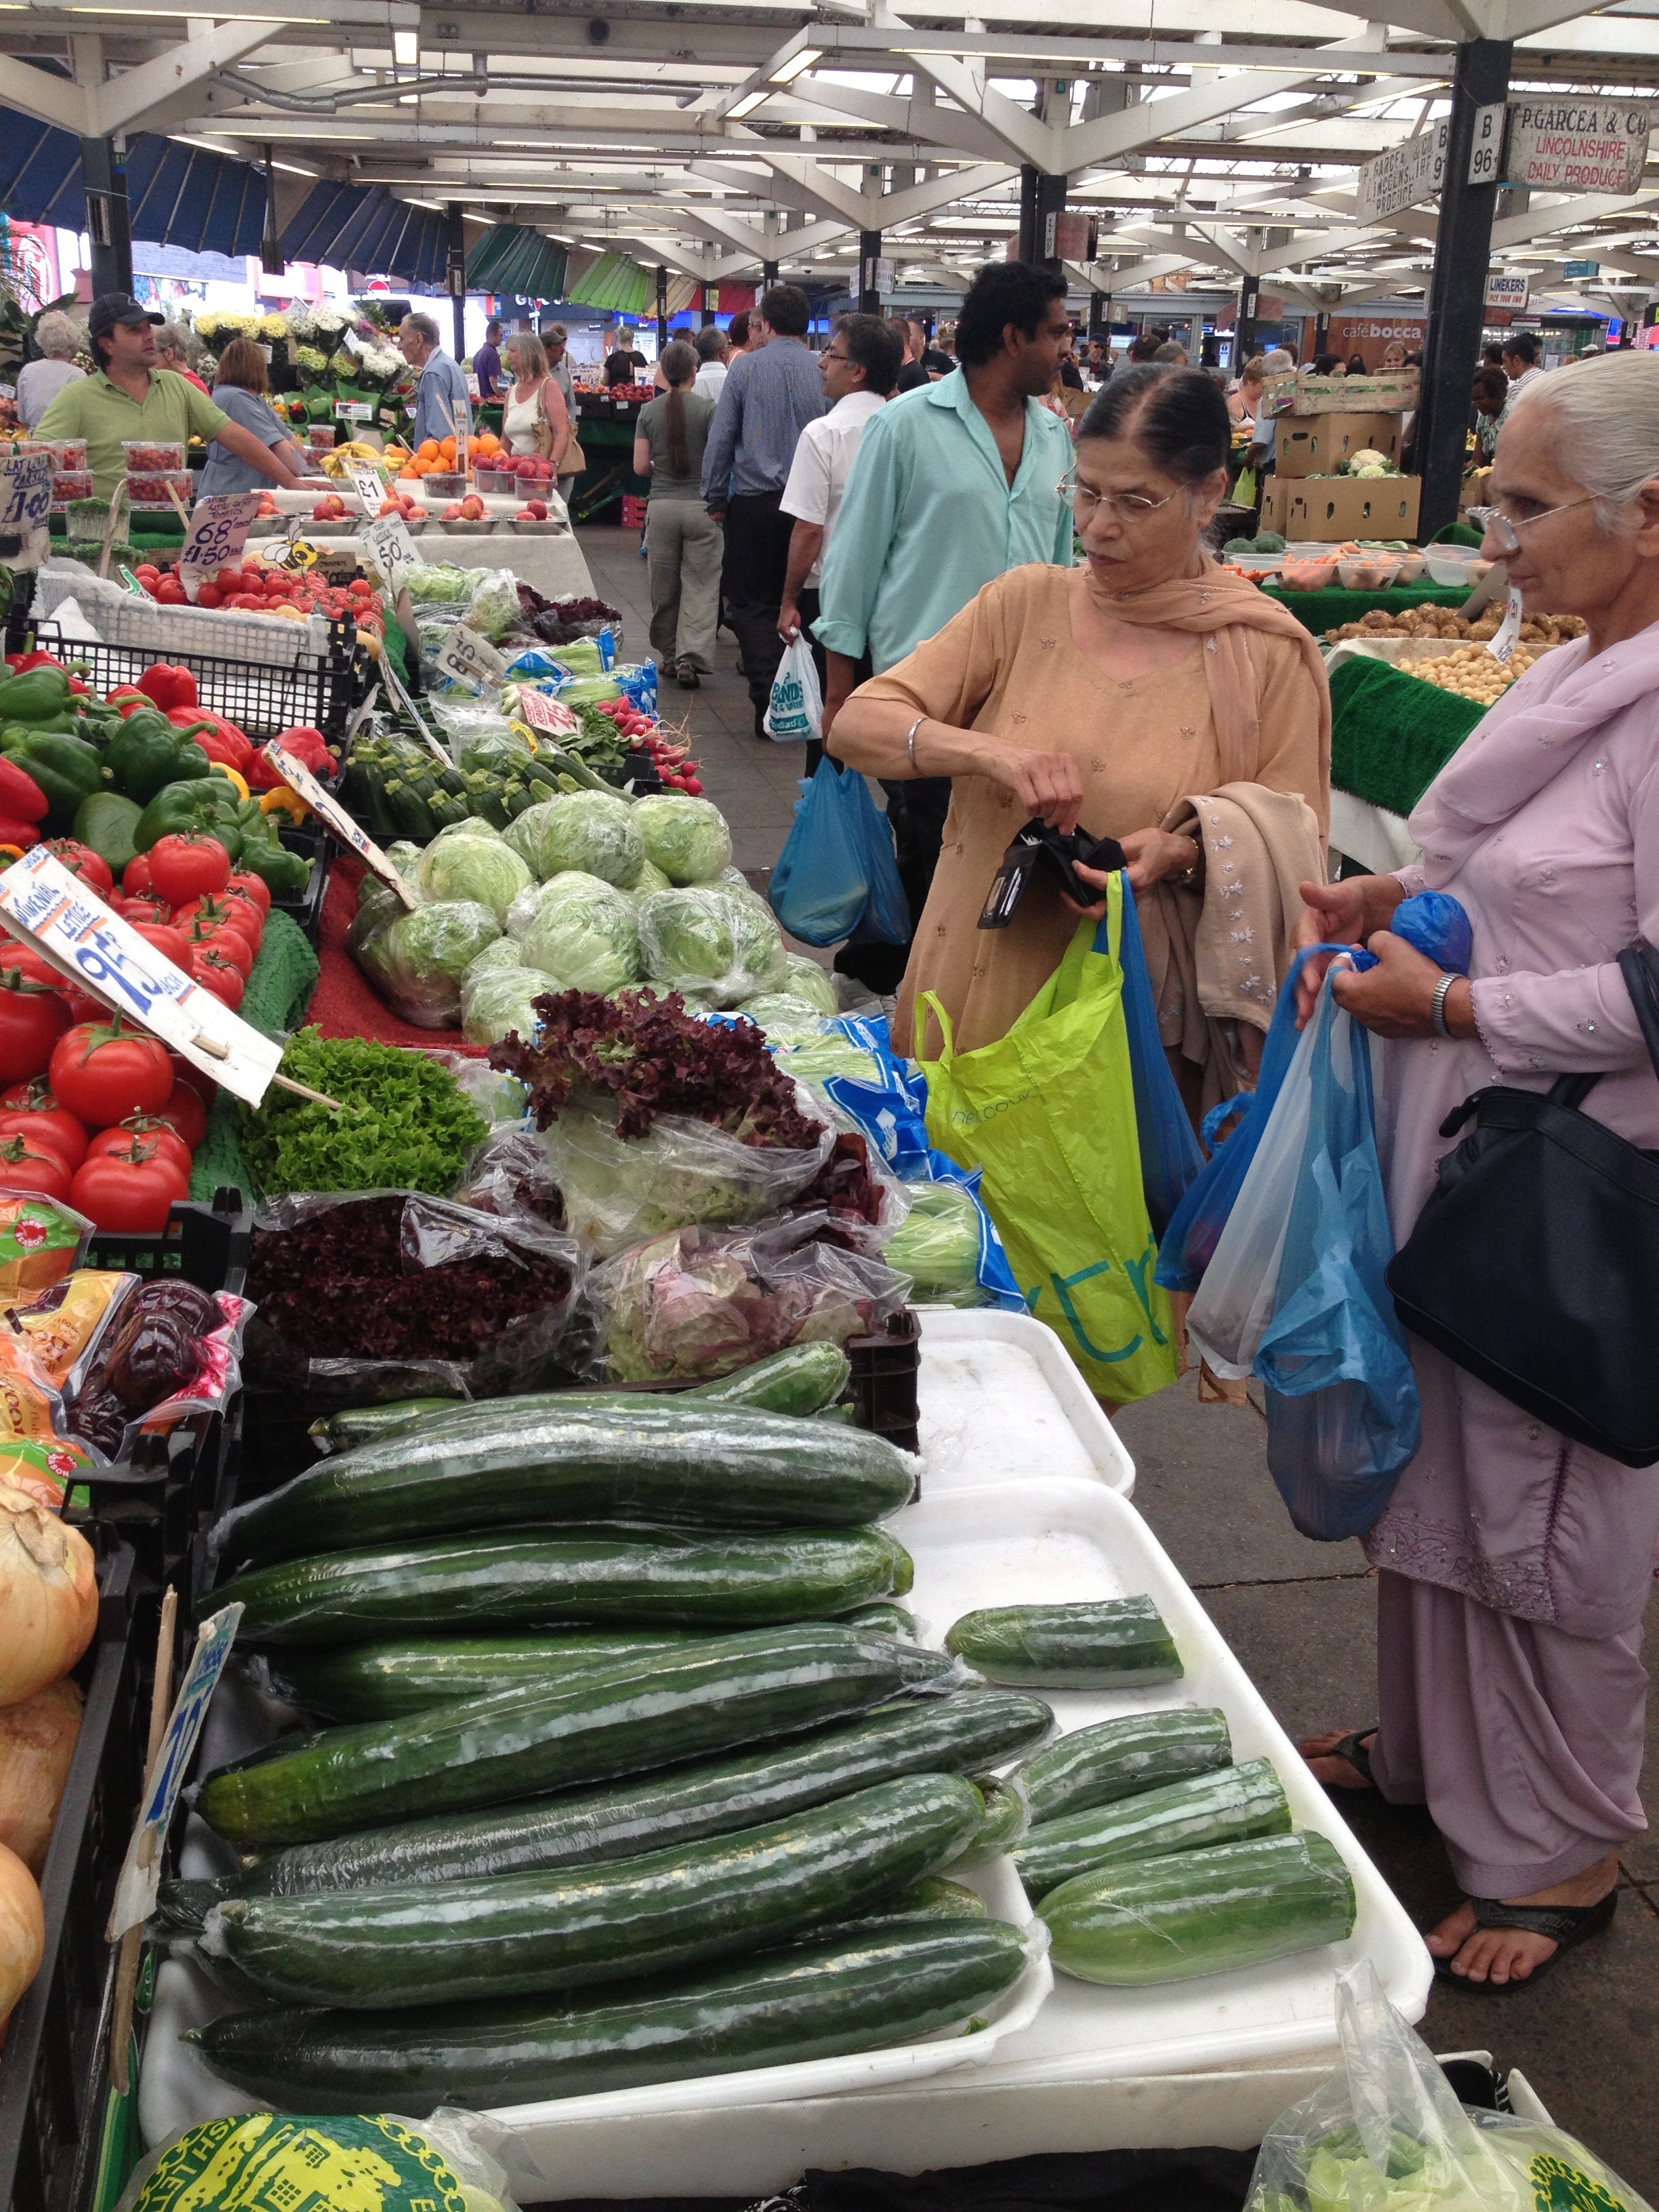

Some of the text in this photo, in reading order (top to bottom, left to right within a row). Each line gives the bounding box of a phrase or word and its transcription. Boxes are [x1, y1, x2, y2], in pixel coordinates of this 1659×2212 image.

[1482, 115, 1492, 139] B
[1605, 110, 1618, 134] &
[1439, 125, 1448, 148] B
[1536, 136, 1626, 161] LINCOLNSHIRE
[1473, 148, 1493, 175] 96
[1527, 162, 1627, 187] DAILY PRODUCE
[1490, 278, 1525, 293] LINEKERS
[358, 478, 380, 498] £1
[182, 545, 230, 566] £1.50
[21, 1219, 44, 1230] NEW
[15, 1232, 45, 1248] SEASON
